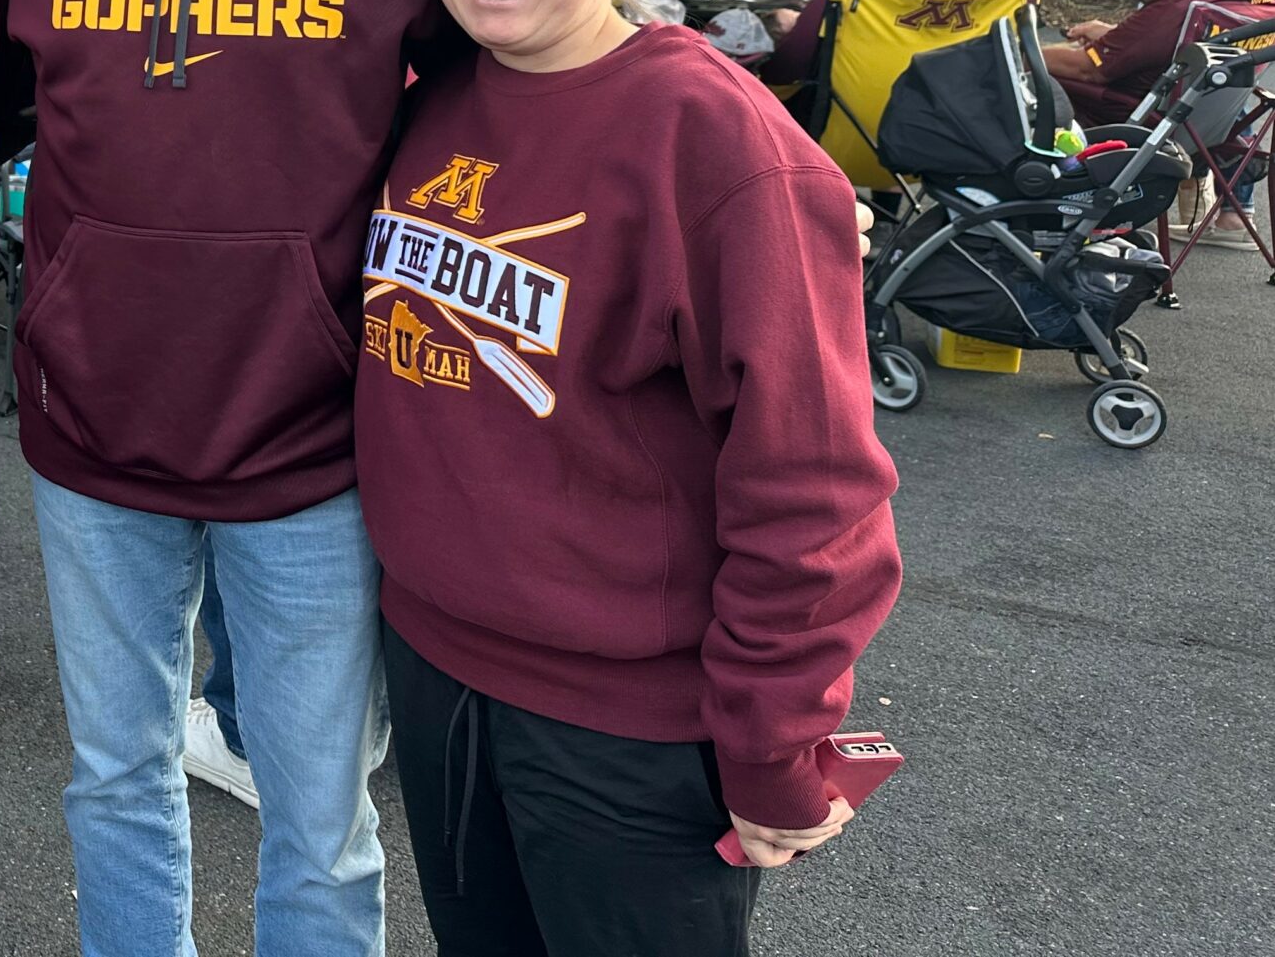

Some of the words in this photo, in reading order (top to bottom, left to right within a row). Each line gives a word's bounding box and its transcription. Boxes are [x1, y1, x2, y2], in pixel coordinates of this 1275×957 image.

[405, 154, 500, 225] M
[398, 233, 436, 275] THE
[430, 237, 556, 336] BOAT
[394, 327, 414, 370] U
[423, 344, 471, 384] MAH
